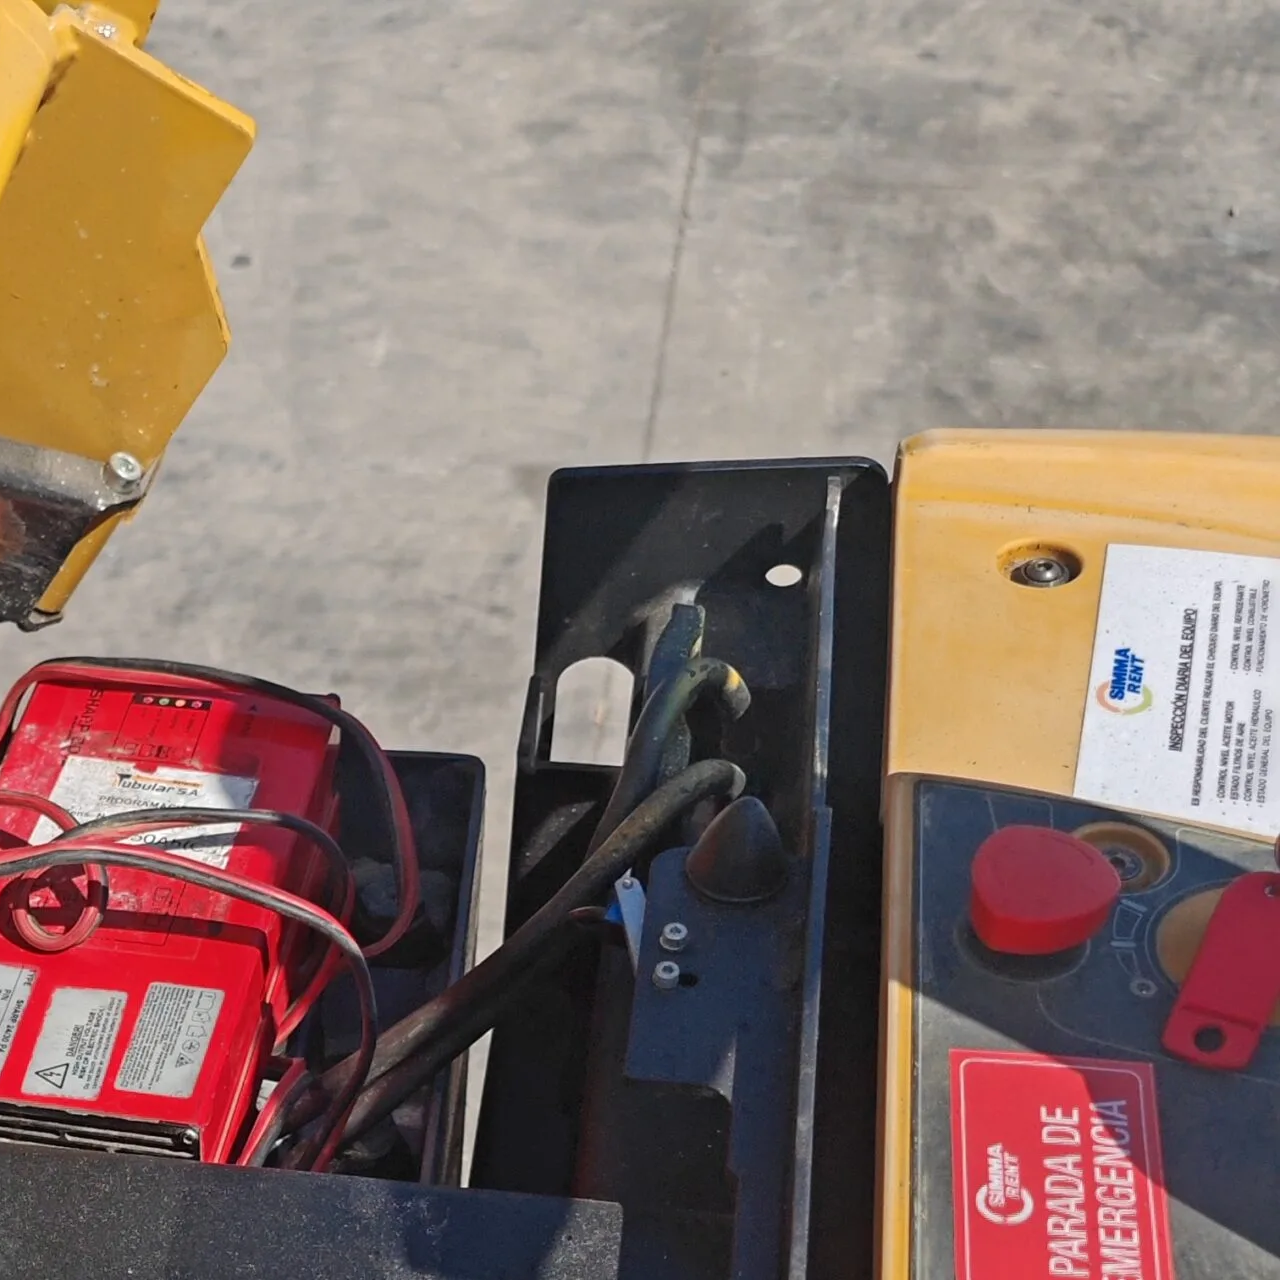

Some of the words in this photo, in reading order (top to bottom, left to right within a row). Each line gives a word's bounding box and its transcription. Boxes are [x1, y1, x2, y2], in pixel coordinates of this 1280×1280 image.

[1180, 608, 1196, 640] EQUIPO
[1179, 642, 1192, 660] DEL
[1230, 643, 1240, 670] CONTROL
[1242, 644, 1253, 672] CONTROL
[1109, 648, 1130, 700] SIMMA
[1127, 654, 1144, 694] RENT
[1176, 661, 1190, 692] DIARIA
[1168, 693, 1187, 752] INSPECCIÓN
[1200, 700, 1210, 725] CLIENTE
[1224, 700, 1234, 724] MOTOR
[1264, 708, 1273, 733] EQUIPO
[1198, 726, 1208, 738] DEL
[1221, 725, 1232, 747] ACEITE
[1235, 738, 1244, 747] DE
[1249, 729, 1258, 750] ACEITE
[1262, 734, 1271, 746] DEL
[1220, 749, 1230, 767] NIVEL
[1232, 748, 1243, 774] FILTROS
[1246, 752, 1256, 770] NIVEL
[1259, 748, 1270, 777] GENERAL
[115, 773, 174, 794] Tubular
[1216, 768, 1228, 798] CONTROL
[1230, 775, 1240, 800] ESTADO
[1243, 772, 1254, 802] CONTROL
[1256, 779, 1267, 804] ESTADO
[9, 999, 24, 1023] SHARP
[1040, 1104, 1082, 1146] DE
[986, 1143, 1004, 1206] SIMMA
[1004, 1151, 1020, 1200] RENT
[1043, 1154, 1090, 1278] PARADA
